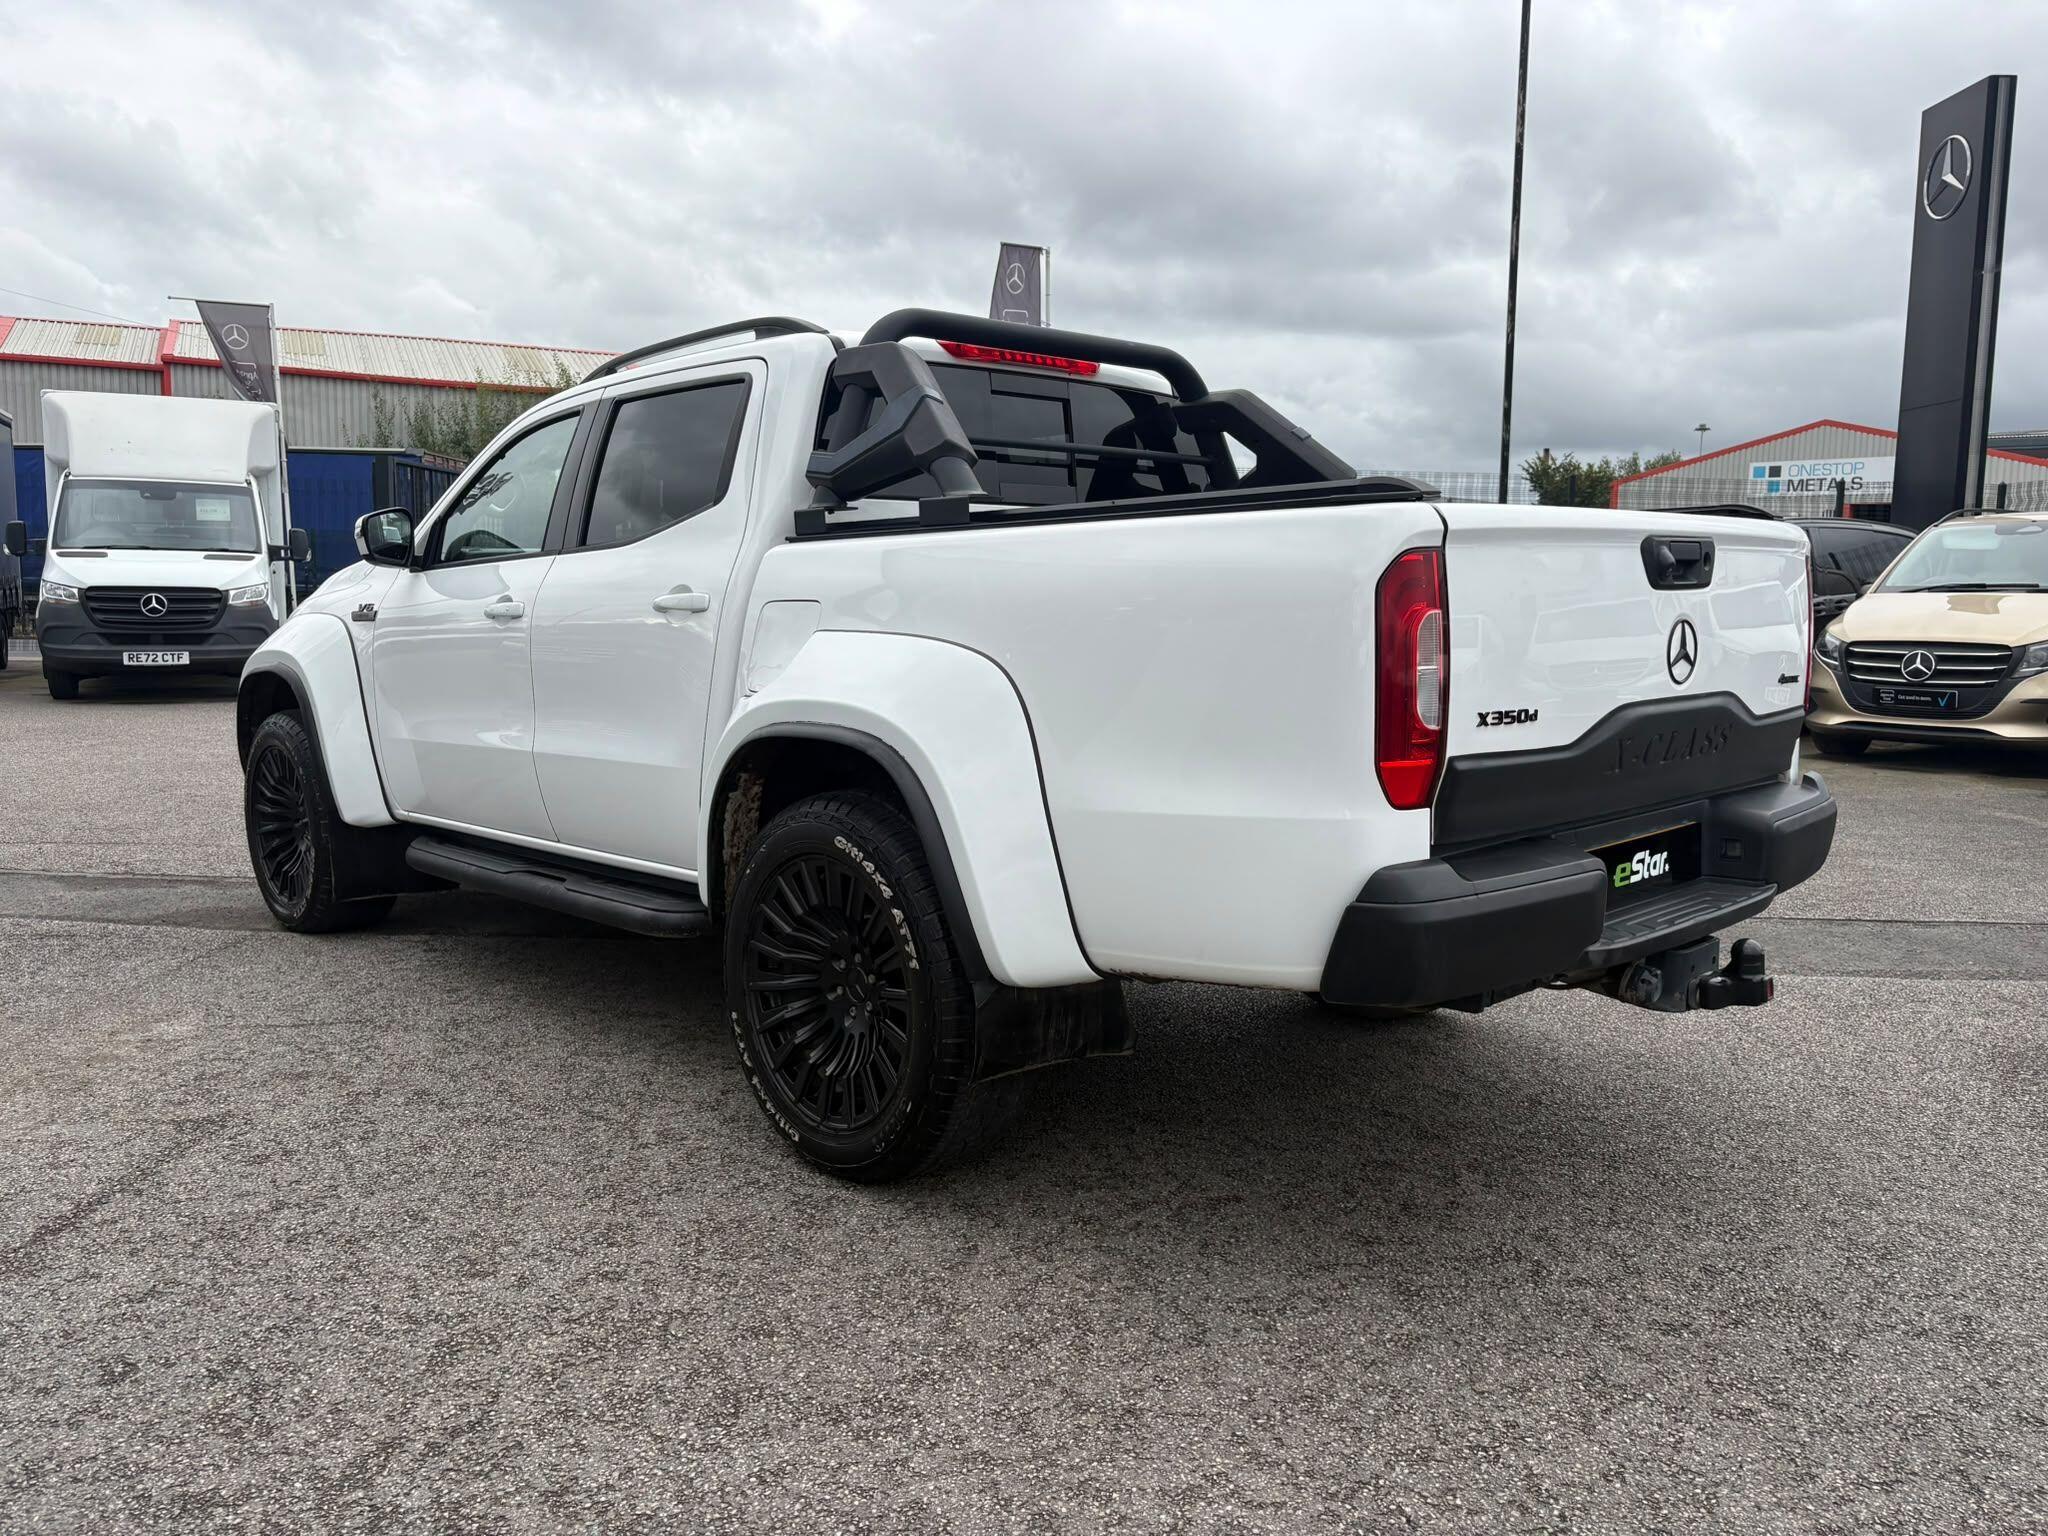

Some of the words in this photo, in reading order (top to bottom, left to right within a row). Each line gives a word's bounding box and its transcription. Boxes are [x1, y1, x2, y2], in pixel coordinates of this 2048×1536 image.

[1788, 462, 1864, 477] ONESTOP
[128, 653, 159, 663] RE72
[161, 653, 184, 663] CTF
[1476, 709, 1539, 727] X350d
[1603, 722, 1735, 775] X-CLASS
